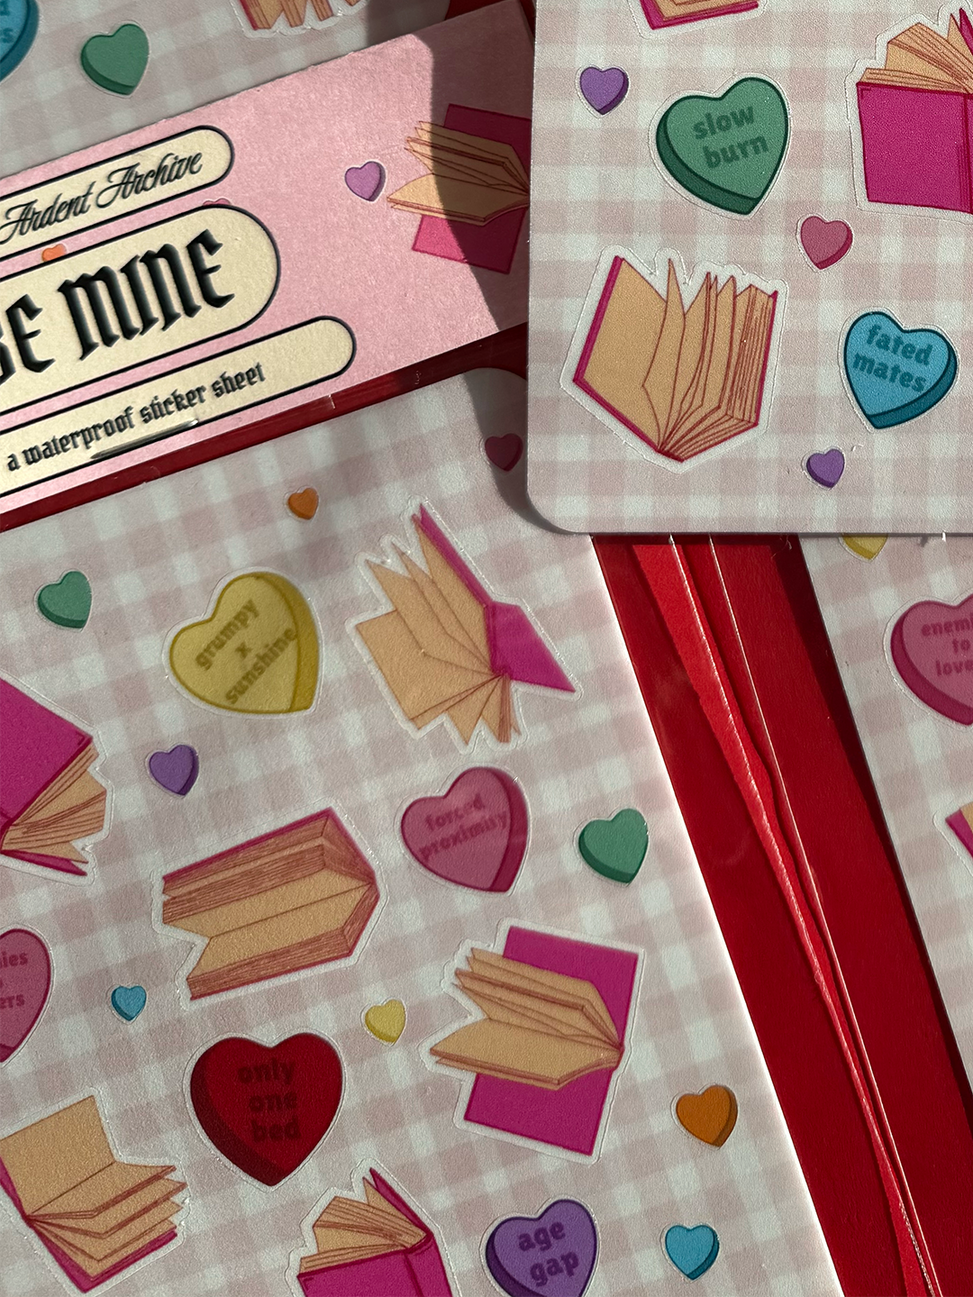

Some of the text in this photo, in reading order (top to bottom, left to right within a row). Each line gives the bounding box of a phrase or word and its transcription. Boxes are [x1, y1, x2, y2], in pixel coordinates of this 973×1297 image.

[692, 105, 755, 141] slow
[702, 135, 770, 170] burn
[0, 148, 205, 246] Ardent Archive
[57, 228, 236, 363] MINE
[866, 322, 934, 366] fated
[852, 352, 928, 393] mates
[6, 360, 268, 473] a waterproof sticker sheet
[195, 598, 260, 673] grumpy
[233, 640, 252, 661] x
[952, 638, 971, 653] to
[224, 626, 299, 706] sunshine
[425, 791, 487, 832] forced
[418, 810, 508, 862] proximity
[0, 993, 26, 1010] ers
[237, 1056, 296, 1086] only
[248, 1091, 299, 1113] one
[250, 1114, 302, 1144] bed
[518, 1220, 566, 1252] age
[530, 1251, 580, 1288] gap
